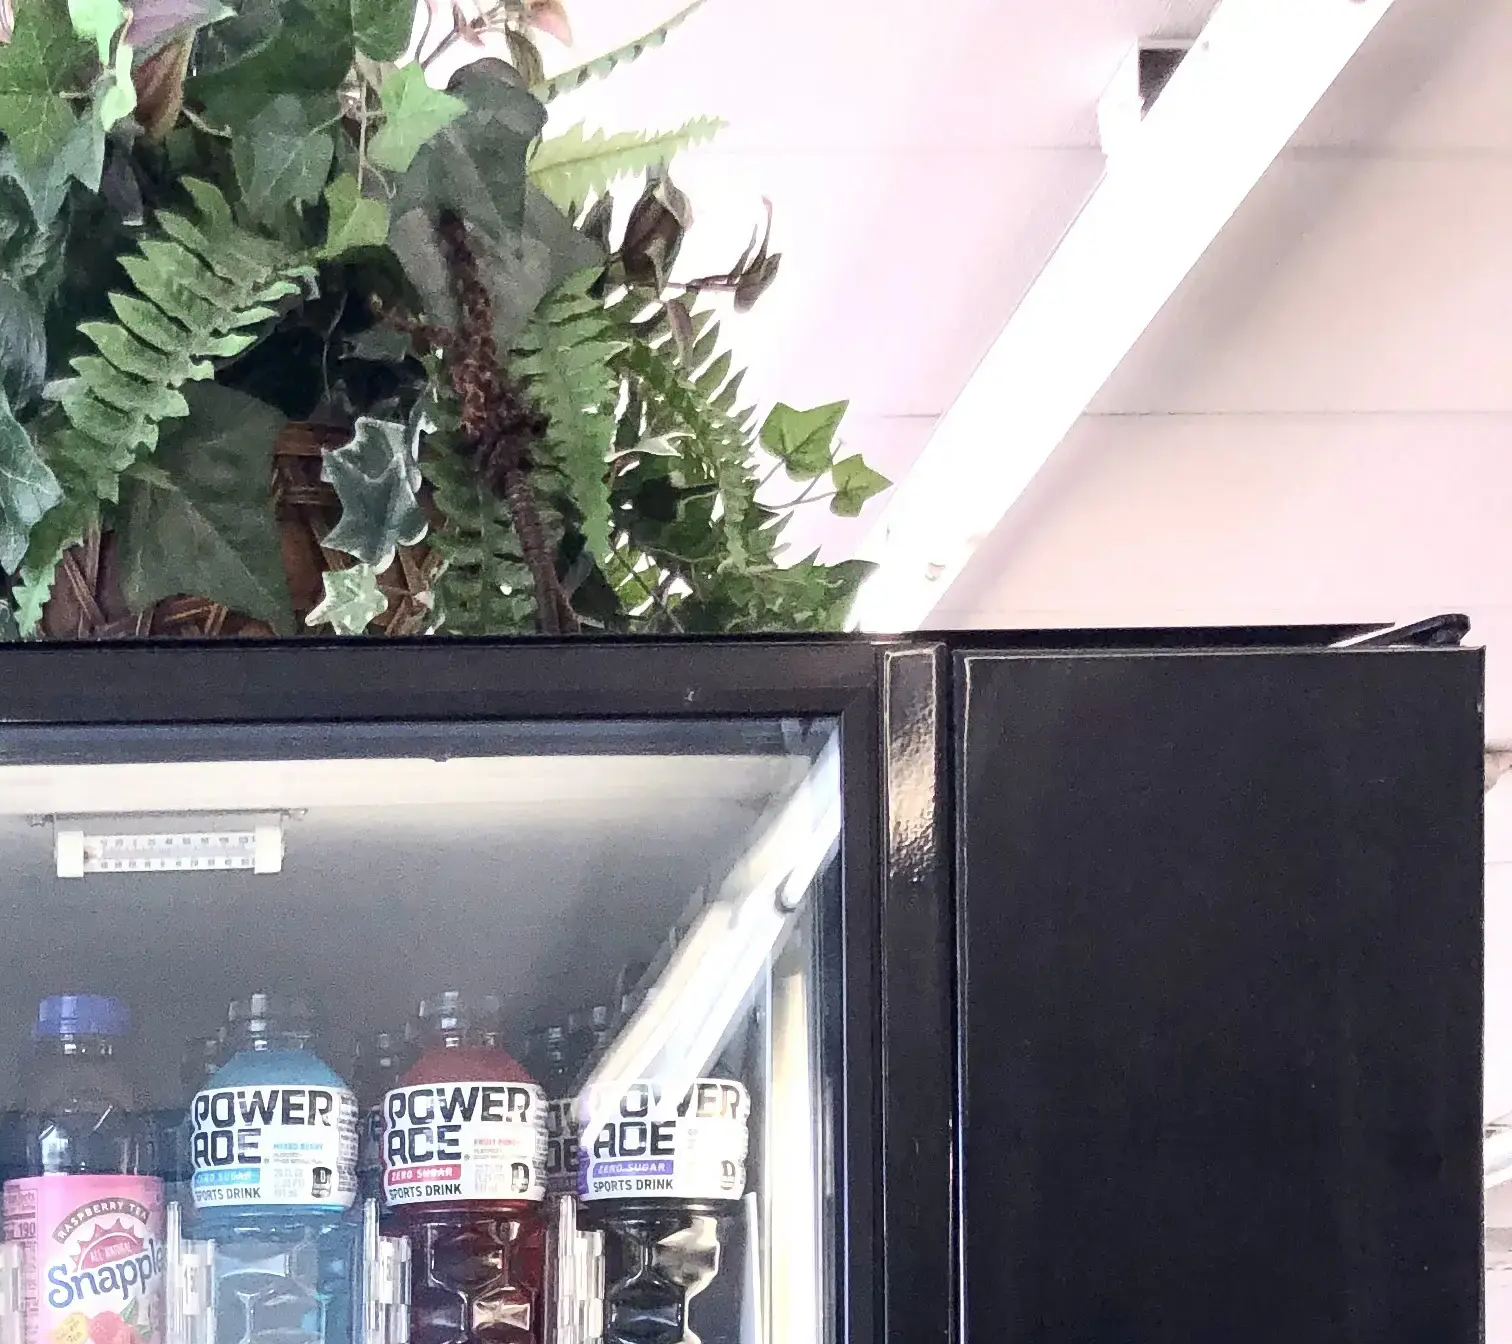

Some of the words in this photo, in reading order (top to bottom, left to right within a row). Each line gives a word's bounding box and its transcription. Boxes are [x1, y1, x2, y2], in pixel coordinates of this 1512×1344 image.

[194, 1089, 333, 1130] POWER
[389, 1086, 531, 1129] POWER
[193, 1127, 262, 1168] ADE
[388, 1124, 462, 1167] ADE
[594, 1120, 677, 1159] ADE
[593, 1179, 633, 1193] SPORTS
[636, 1178, 674, 1191] DRINK
[626, 1161, 666, 1174] SUGAR
[195, 1188, 224, 1201] SPORTS
[226, 1186, 261, 1199] DRINK
[389, 1186, 422, 1200] SPORTS
[425, 1184, 462, 1197] DRINK
[57, 1199, 125, 1241] RASPBERRY
